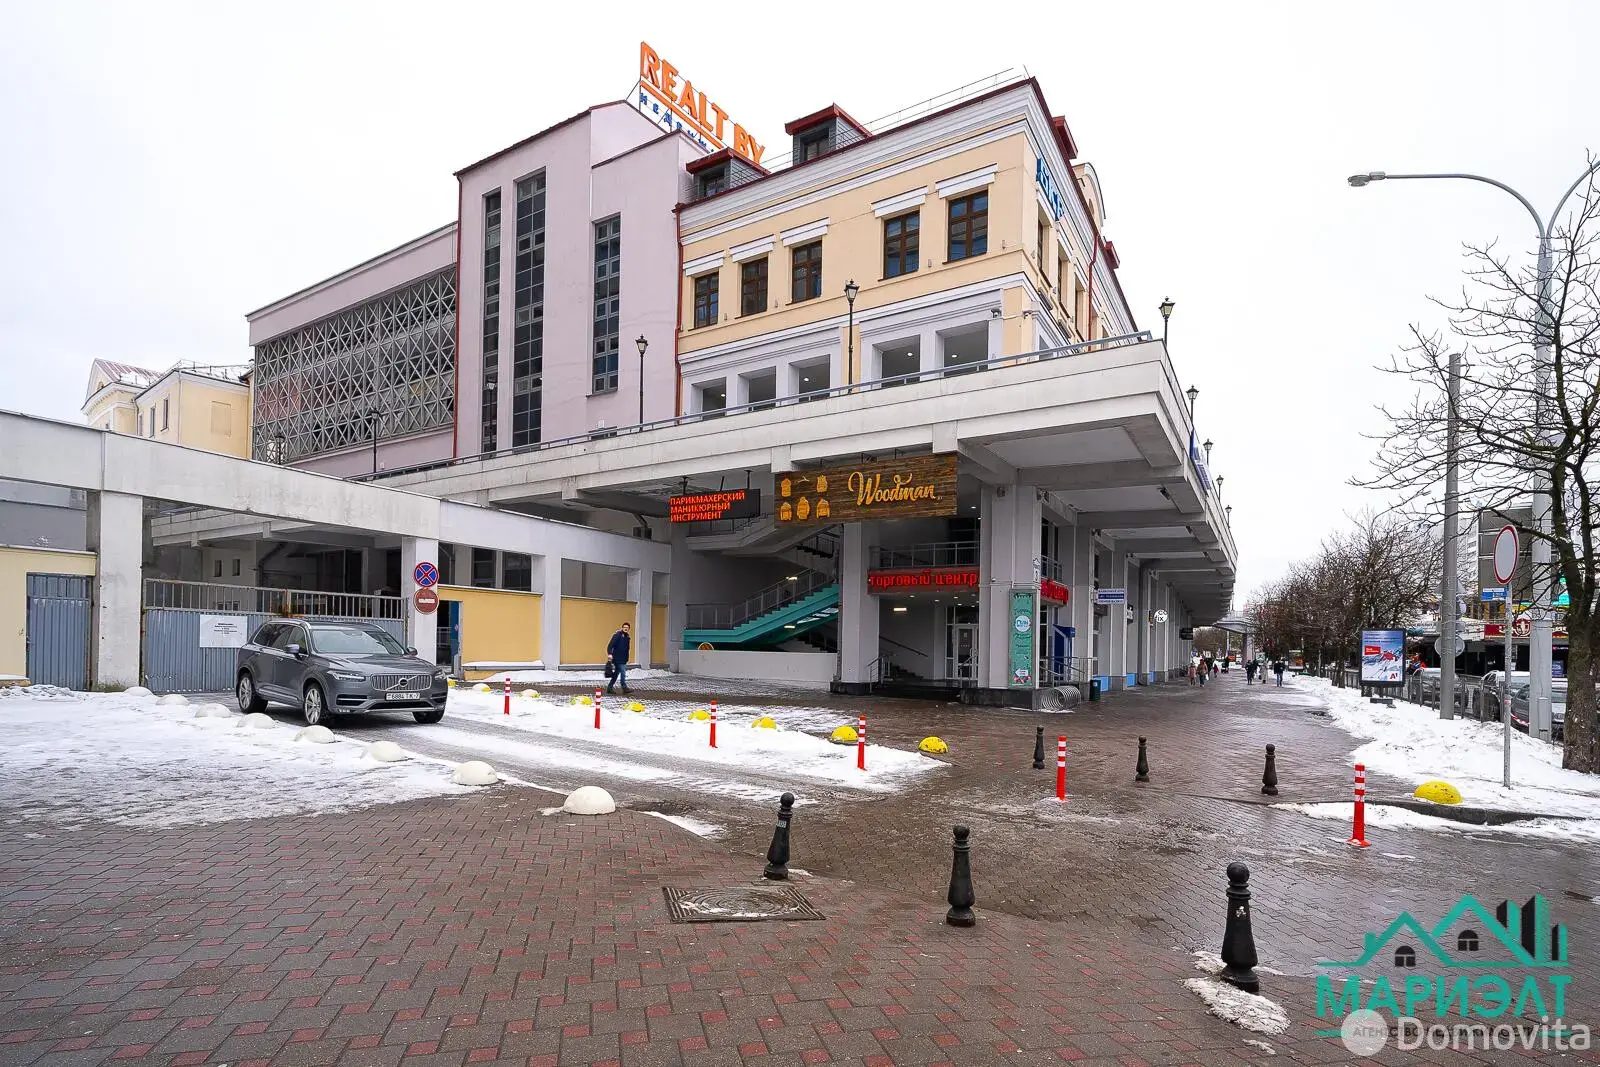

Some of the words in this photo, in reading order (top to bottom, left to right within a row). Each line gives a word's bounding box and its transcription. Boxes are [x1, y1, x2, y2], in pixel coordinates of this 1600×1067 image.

[848, 471, 936, 506] Woodman
[670, 490, 745, 505] ПАРИКМАХЕРСКИЙ
[670, 502, 731, 514] МАНИКЮРНЫЙ
[670, 511, 722, 523] ИНСТРУМЕНТ
[869, 570, 930, 588] торговый
[935, 572, 978, 588] центр
